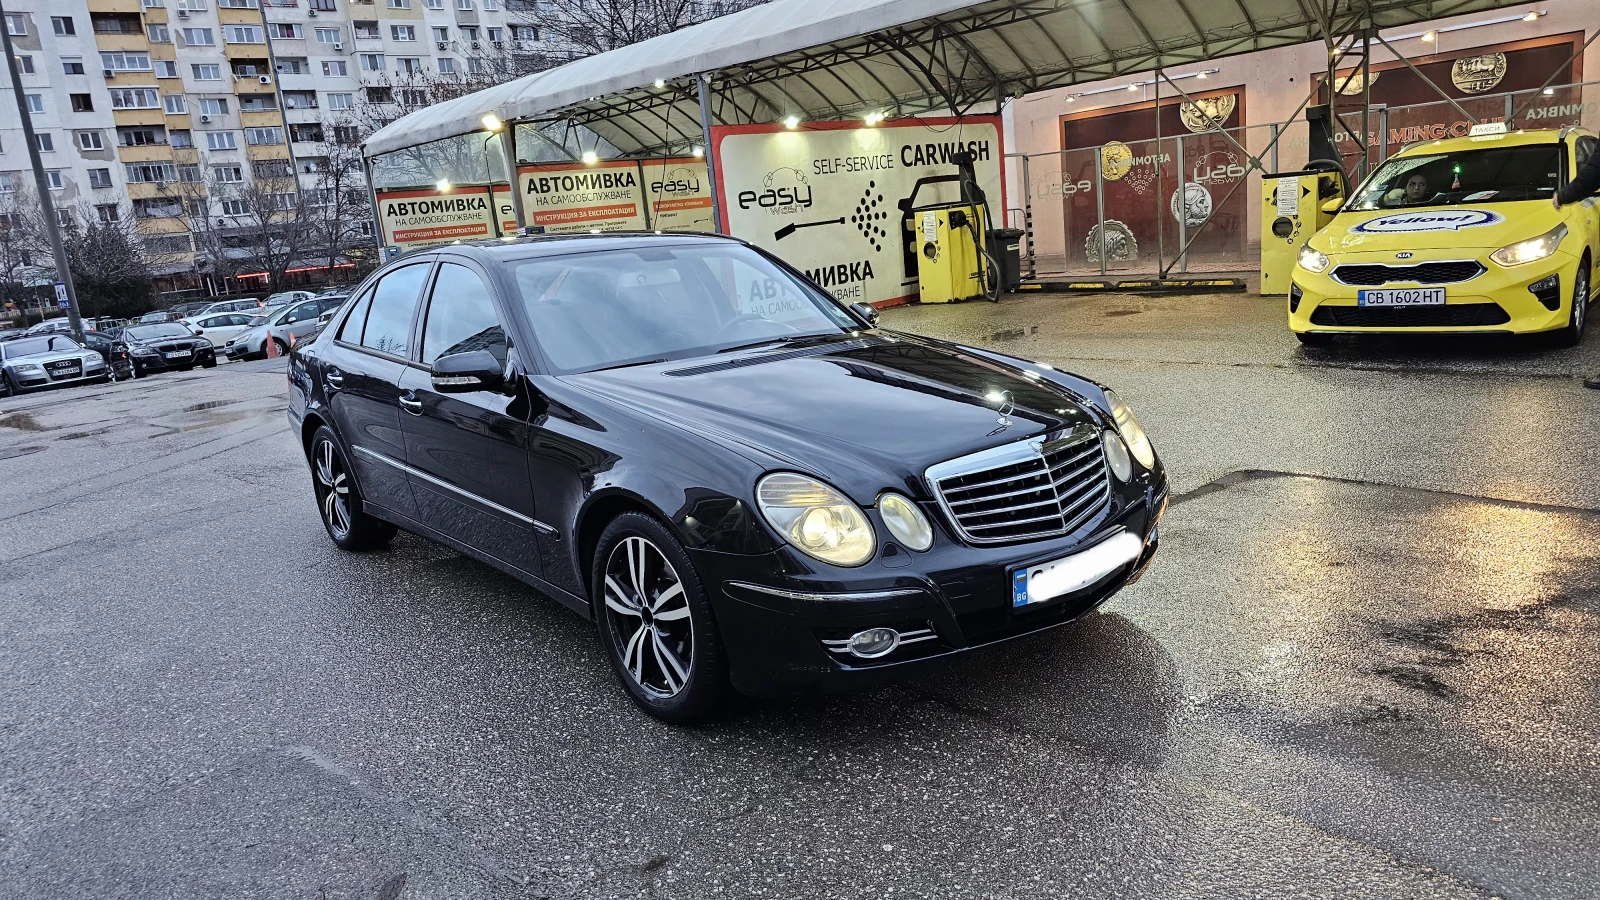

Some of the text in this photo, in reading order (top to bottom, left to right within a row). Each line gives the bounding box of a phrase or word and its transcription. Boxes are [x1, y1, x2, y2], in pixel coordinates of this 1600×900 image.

[1474, 125, 1501, 134] ТАКСИ
[813, 140, 990, 175] SELF-SERVICE CARWASH
[527, 172, 637, 194] АВТОМИВКА
[651, 179, 700, 193] easy
[536, 190, 632, 206] НА САМООБСЛУЖВАНЕ
[738, 185, 812, 215] easy wash
[387, 197, 488, 217] АВТОМИВКА
[536, 213, 578, 222] ИНСТРУКЦИЯ
[589, 207, 635, 217] ЕКСПЛОАТАЦИЯ
[395, 211, 483, 227] НА САМООБСЛУЖВАНЕ
[1378, 214, 1475, 227] Yellow!
[1367, 290, 1442, 304] CB 1602 HT
[1016, 591, 1027, 603] BG
